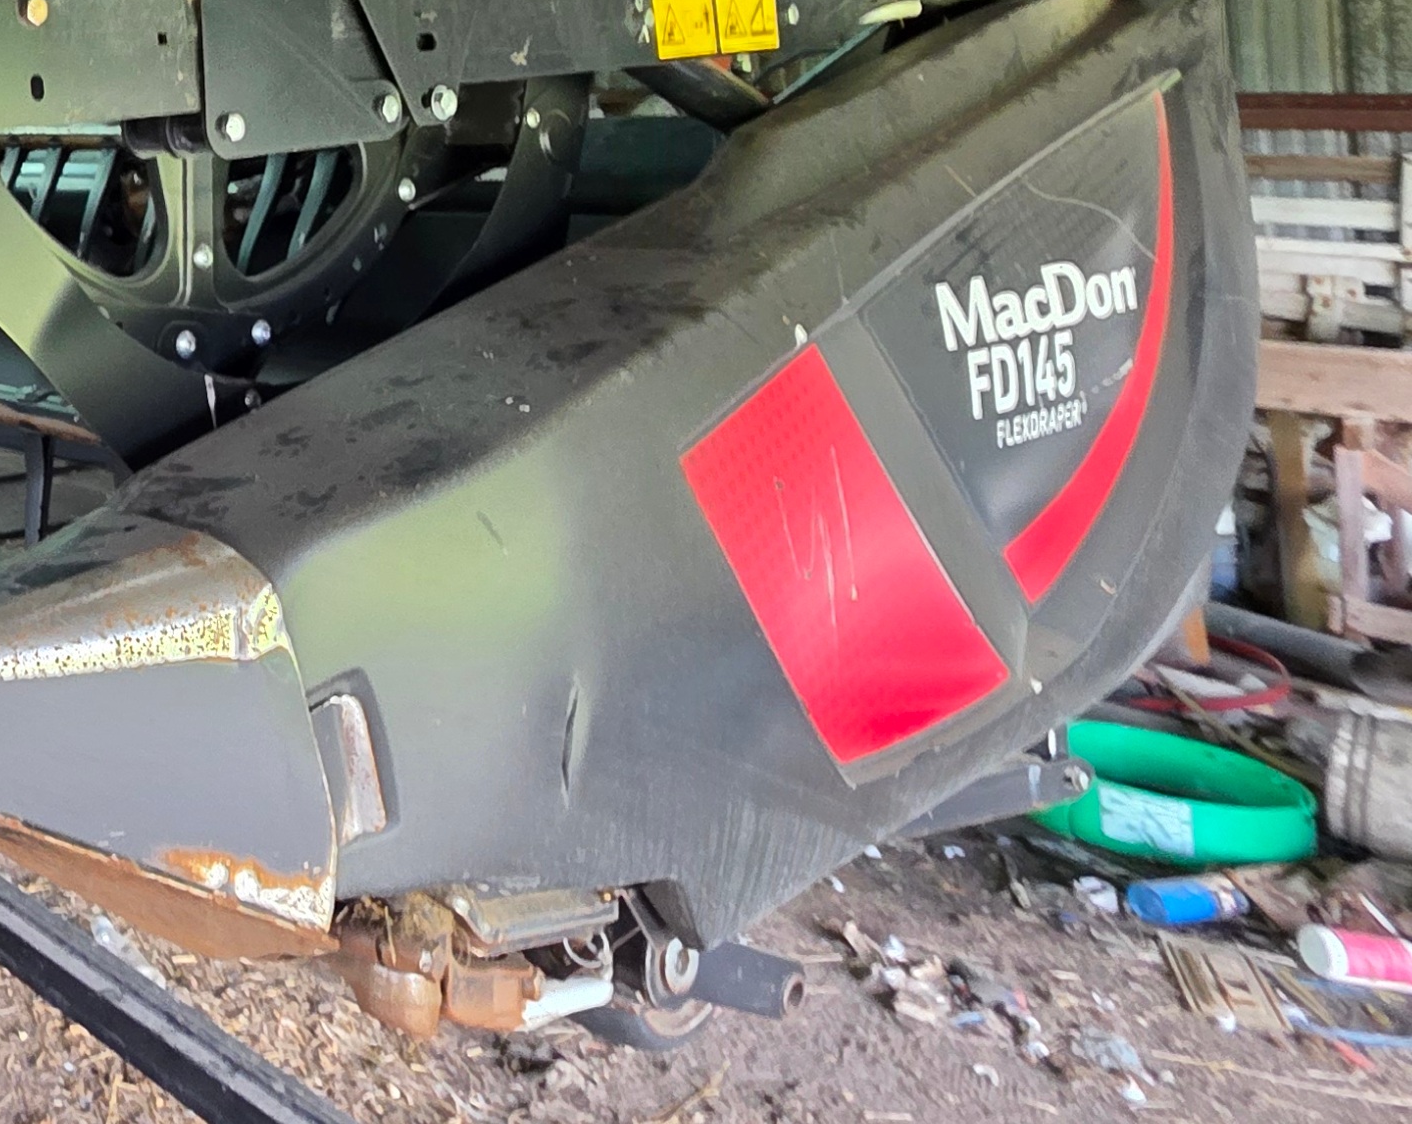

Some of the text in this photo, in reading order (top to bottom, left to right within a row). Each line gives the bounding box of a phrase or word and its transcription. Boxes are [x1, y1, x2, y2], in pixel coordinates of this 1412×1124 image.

[935, 260, 1137, 352] MacDon
[967, 329, 1076, 420] FD145
[996, 399, 1082, 449] FLEXDRAPER
